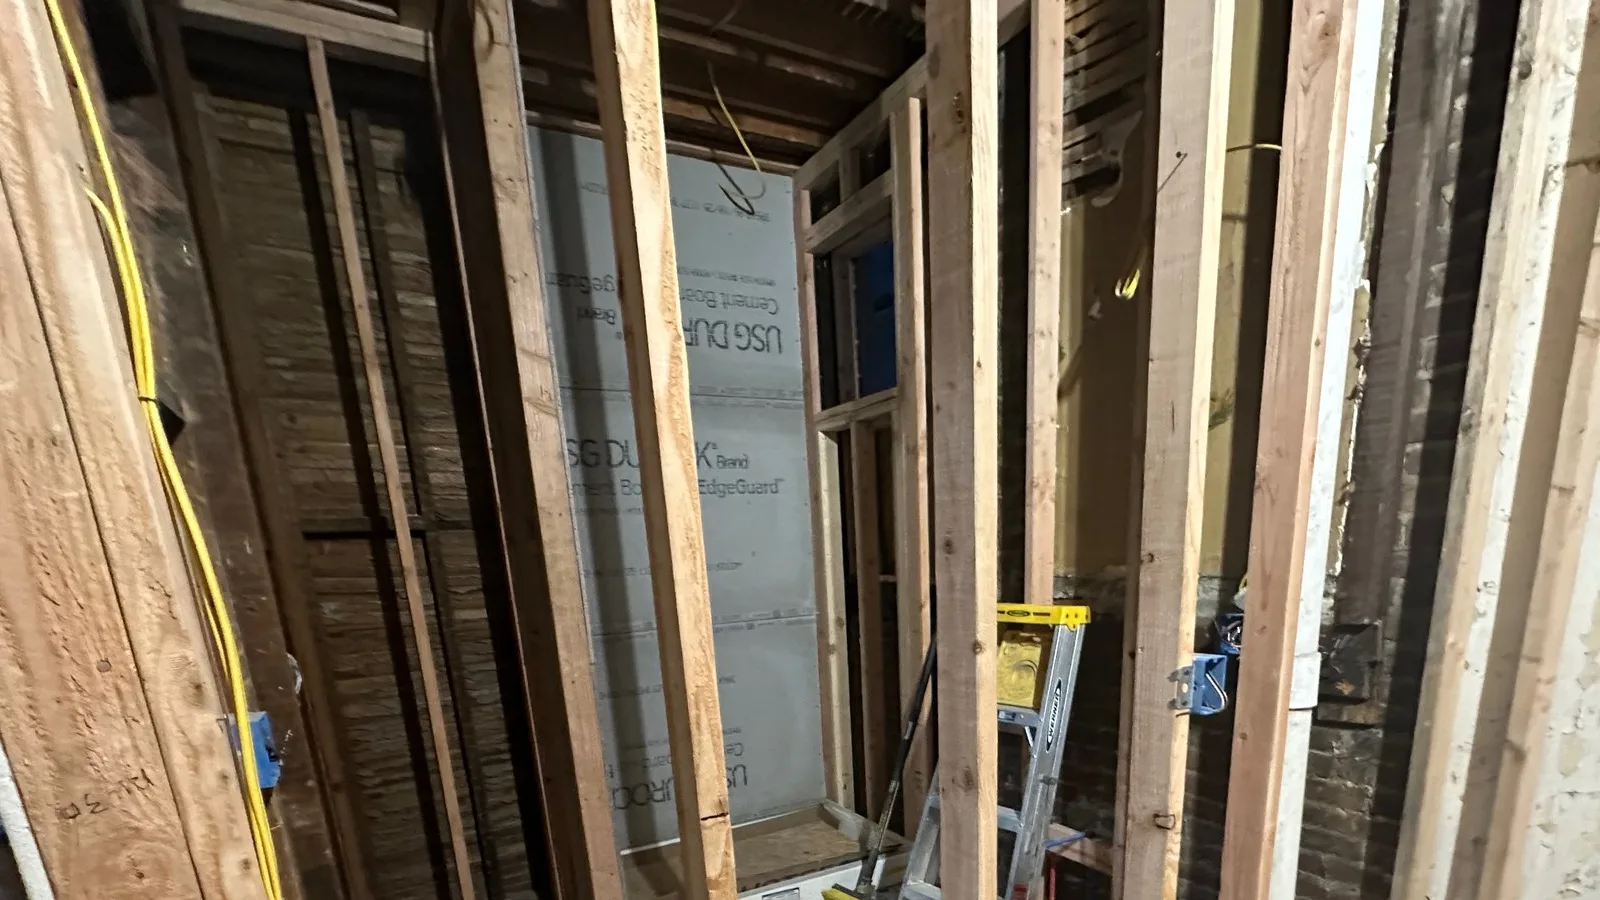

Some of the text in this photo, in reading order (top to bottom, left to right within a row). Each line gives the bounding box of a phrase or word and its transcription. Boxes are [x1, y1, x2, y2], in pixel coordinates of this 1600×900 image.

[719, 292, 779, 315] Cement
[734, 322, 782, 354] USG
[566, 438, 602, 468] SG
[716, 454, 749, 470] Brand
